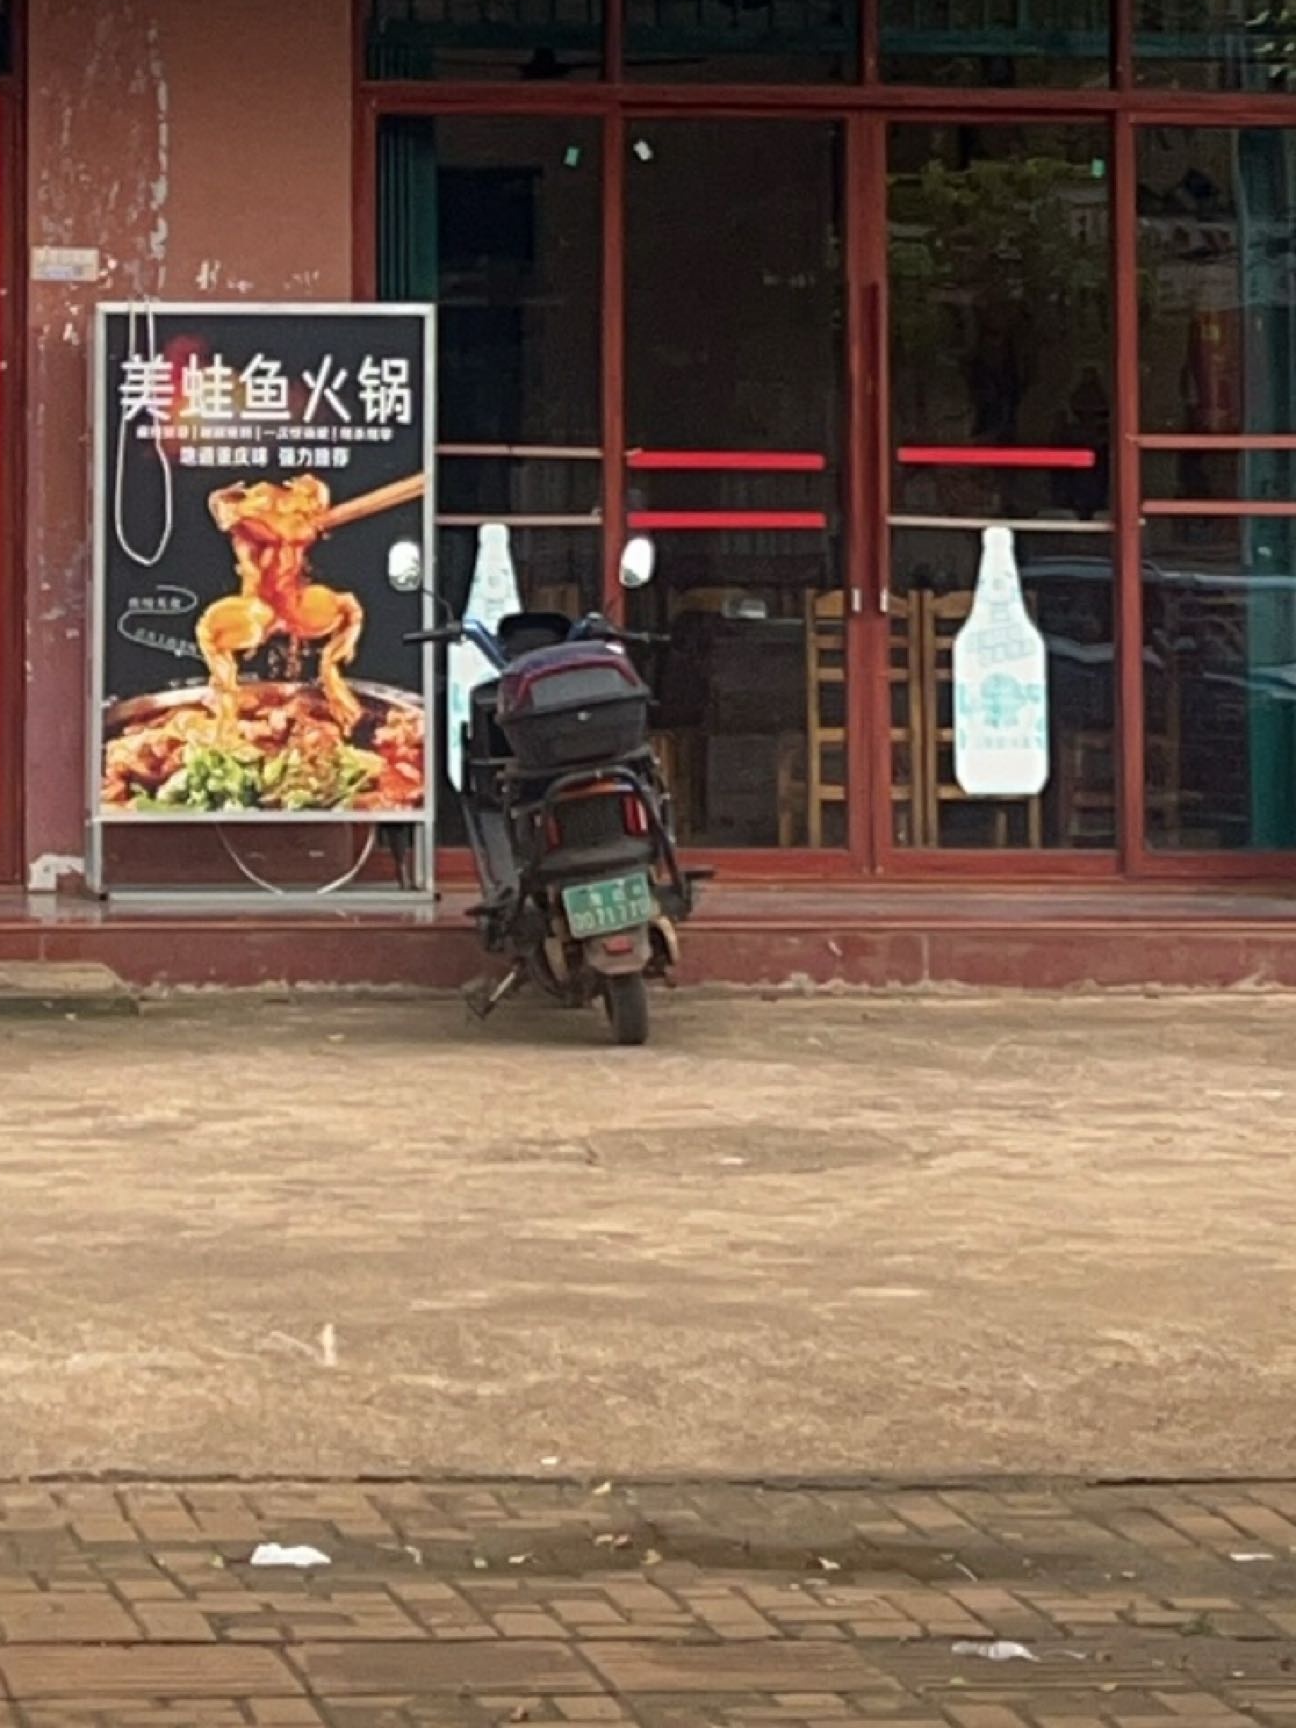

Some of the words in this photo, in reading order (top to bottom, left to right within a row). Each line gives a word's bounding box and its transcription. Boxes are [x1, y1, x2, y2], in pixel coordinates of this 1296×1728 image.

[118, 352, 412, 425] 美蛙鱼火锅
